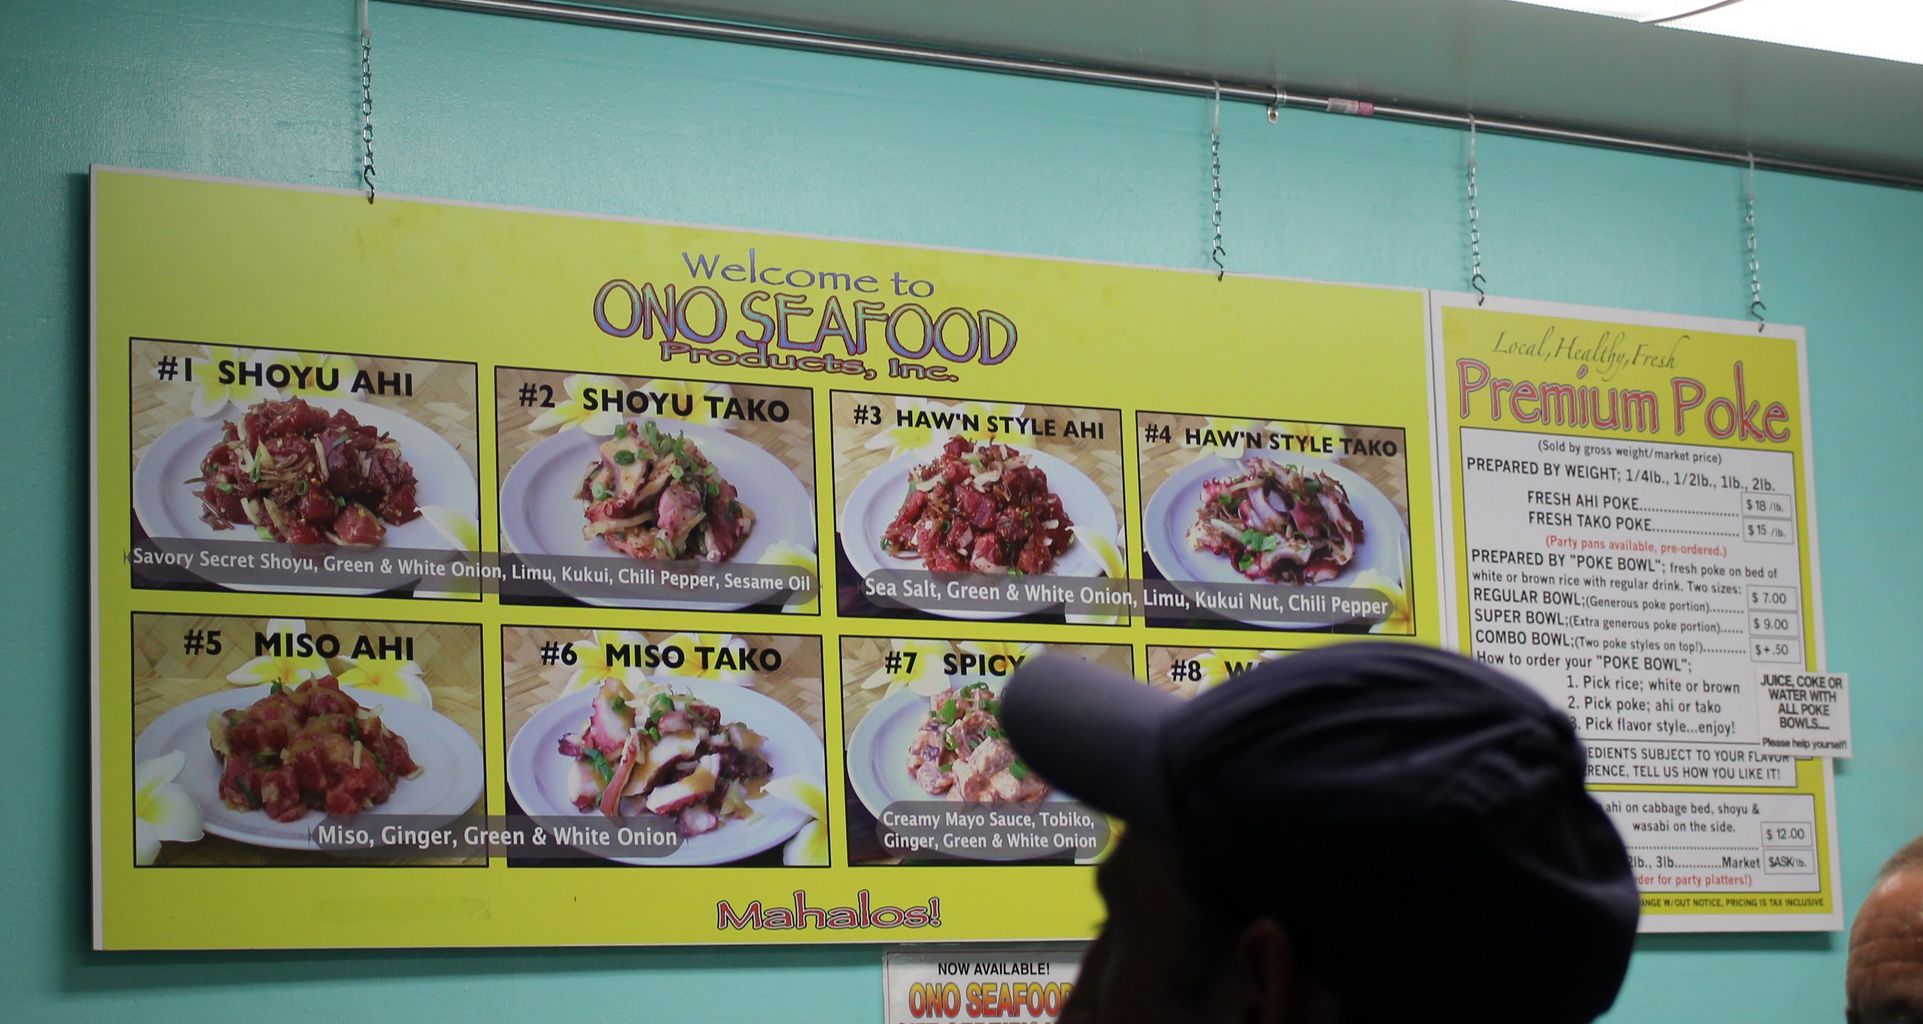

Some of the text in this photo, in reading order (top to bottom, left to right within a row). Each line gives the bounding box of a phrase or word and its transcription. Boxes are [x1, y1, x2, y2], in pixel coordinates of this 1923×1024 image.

[682, 248, 934, 298] Welcome to
[593, 279, 1018, 366] ONO SEAFOOD
[659, 340, 960, 382] Products, Inc.
[158, 355, 412, 397] #1 SHOYU AHI
[519, 382, 790, 423] #2 SHOYU TAKO
[1456, 358, 1790, 443] Premium Poke
[853, 404, 1104, 440] #3 HAW'N STYLE AHI
[1145, 423, 1398, 457] #4 HAW'N STYLE TAKO
[1538, 439, 1565, 452] (Sold
[1569, 442, 1580, 455] by
[1584, 445, 1612, 456] gross
[1693, 454, 1722, 465] price)
[1467, 457, 1775, 491] PREPARED BY WEIGHT; 1/4lb., 1/2lb., 1lb., 2lb.
[1528, 490, 1598, 508] FRESH AHI
[1755, 500, 1766, 512] 18
[1529, 511, 1611, 529] FRESH TAKO
[1757, 524, 1767, 535] 15
[1546, 535, 1577, 550] (Party
[1581, 540, 1606, 550] pans
[1609, 540, 1657, 553] available,
[132, 548, 810, 591] Savory Secret Shoyu, Green & White Onion, Limu, Kukui, Chili Pepper, Sesame Oil
[1472, 548, 1777, 578] PREPARED BY "POKE BOWL"; fresh poke on bed of
[1472, 570, 1741, 594] white or brown rice with regular drink. Two sizes:
[865, 578, 1388, 616] Sea Salt, Green & White Onion, Limu, Kukui Nut, Chili Pepper
[1763, 592, 1787, 604] 7.00
[1764, 618, 1788, 630] 9.00
[184, 629, 413, 660] #5 MISO AHI
[540, 641, 782, 672] #6 MISO TAKO
[885, 650, 1026, 676] #7 SPICY
[1476, 651, 1692, 673] How to order your "POKE BOWL";
[1171, 659, 1202, 682] #8
[1760, 674, 1842, 688] JUICE, COKE OR
[1568, 674, 1740, 693] 1. Pick rice; white or brown
[1768, 688, 1837, 702] WATER WITH
[1568, 695, 1721, 713] 2. Pick poke; ahi or tako
[1778, 703, 1830, 716] ALL POKE
[1586, 717, 1613, 730] Pick
[1618, 718, 1652, 731] flavor
[883, 811, 1094, 830] Creamy Mayo Sauce, Tobiko,
[1632, 820, 1736, 832] wasabi on the side.
[318, 825, 677, 849] Miso, Ginger, Green & White Onion
[884, 832, 1097, 851] Ginger, Green & White Onion
[1777, 828, 1804, 840] 12.00
[716, 889, 942, 931] Mahalos!
[938, 962, 1050, 976] NOW AVAILABLE!
[908, 981, 962, 1018] ONO
